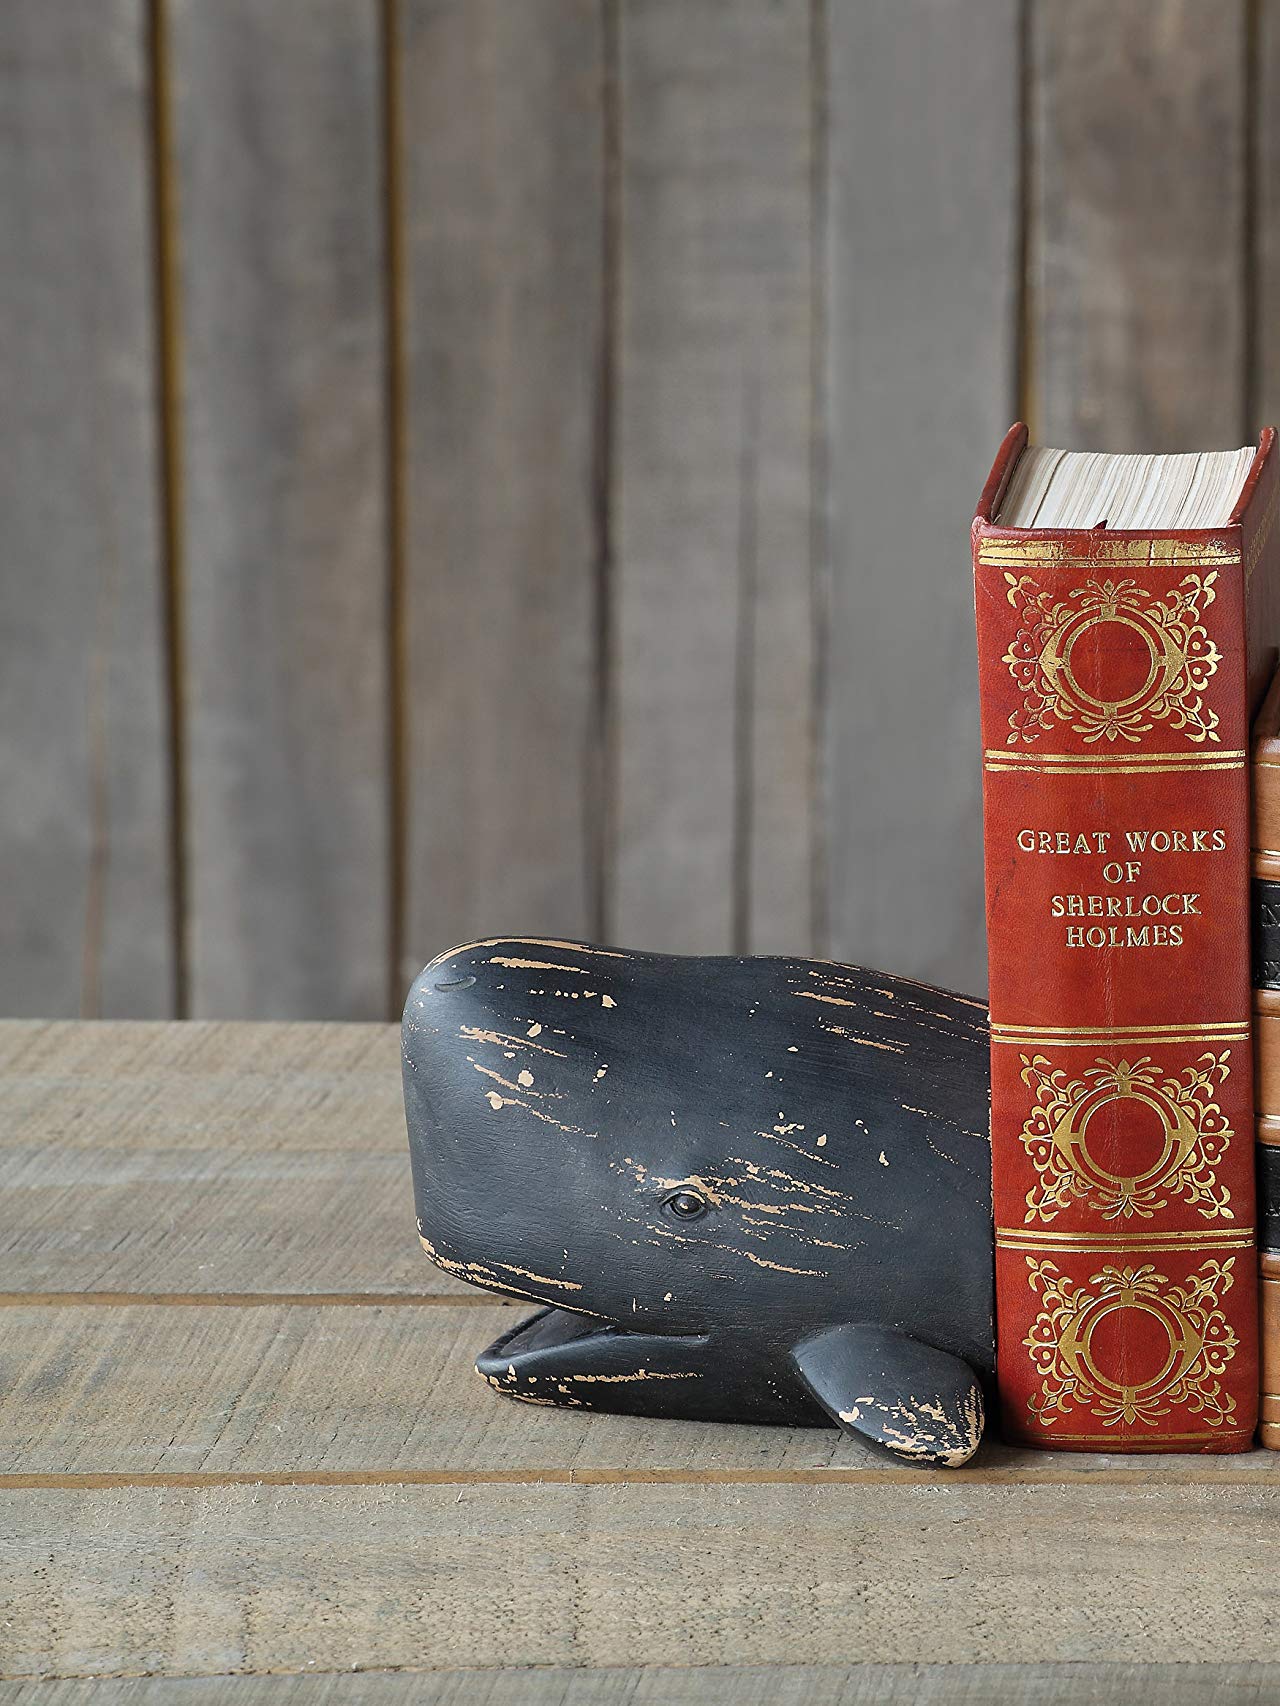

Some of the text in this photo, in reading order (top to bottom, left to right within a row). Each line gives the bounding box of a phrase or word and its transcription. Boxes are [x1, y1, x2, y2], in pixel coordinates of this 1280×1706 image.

[1016, 829, 1227, 855] GREAT WORKS
[1103, 861, 1142, 884] OF
[1051, 893, 1202, 917] SHERLOCK
[1065, 924, 1184, 947] HOLMES
